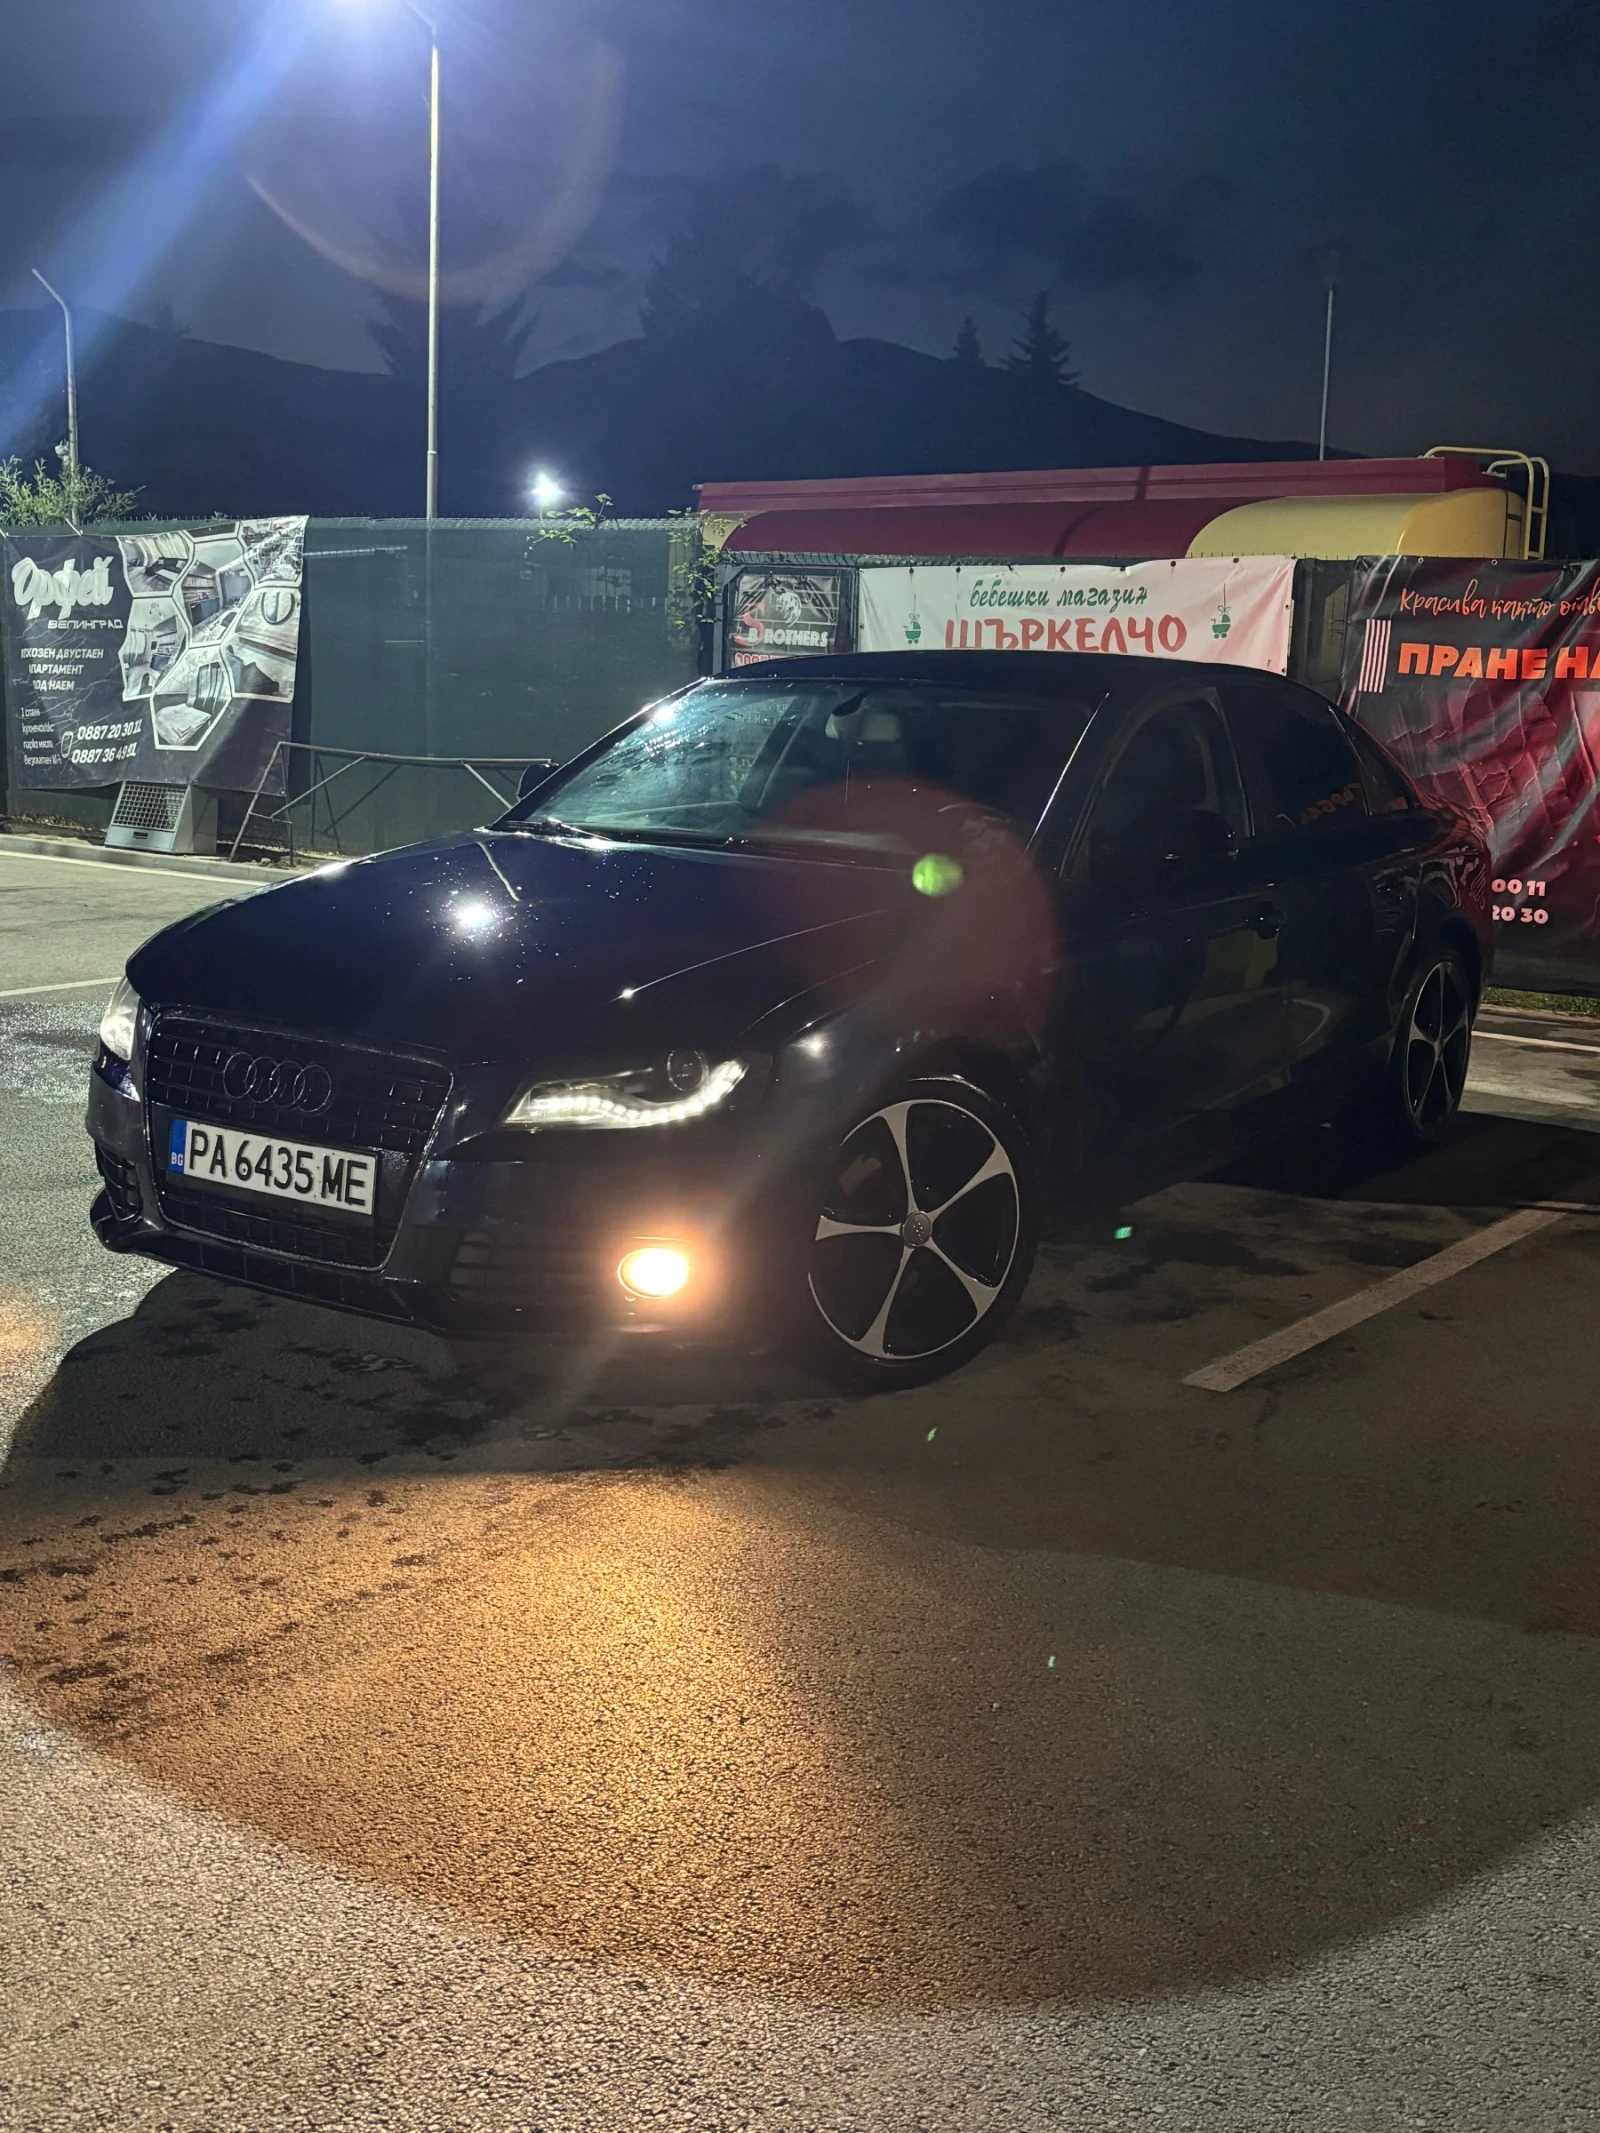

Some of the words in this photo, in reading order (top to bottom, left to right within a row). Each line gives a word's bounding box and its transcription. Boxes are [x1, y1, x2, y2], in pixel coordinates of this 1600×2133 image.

[970, 579, 1050, 608] бебешки
[1056, 586, 1148, 613] магазин
[945, 613, 1188, 654] ШЪРКЕЛЧО
[56, 648, 104, 660] ДВУСТАЕН
[1398, 642, 1548, 680] ПРАНЕ
[48, 680, 75, 690] НАЕМ
[77, 725, 108, 740] 0887
[107, 724, 122, 739] 20
[121, 721, 134, 737] 30
[133, 719, 143, 734] 11
[71, 749, 103, 764] 0887
[102, 747, 116, 763] 36
[1491, 879, 1523, 894] 00
[1526, 881, 1546, 897] 11
[1520, 908, 1549, 925] 30
[171, 1152, 184, 1166] BG
